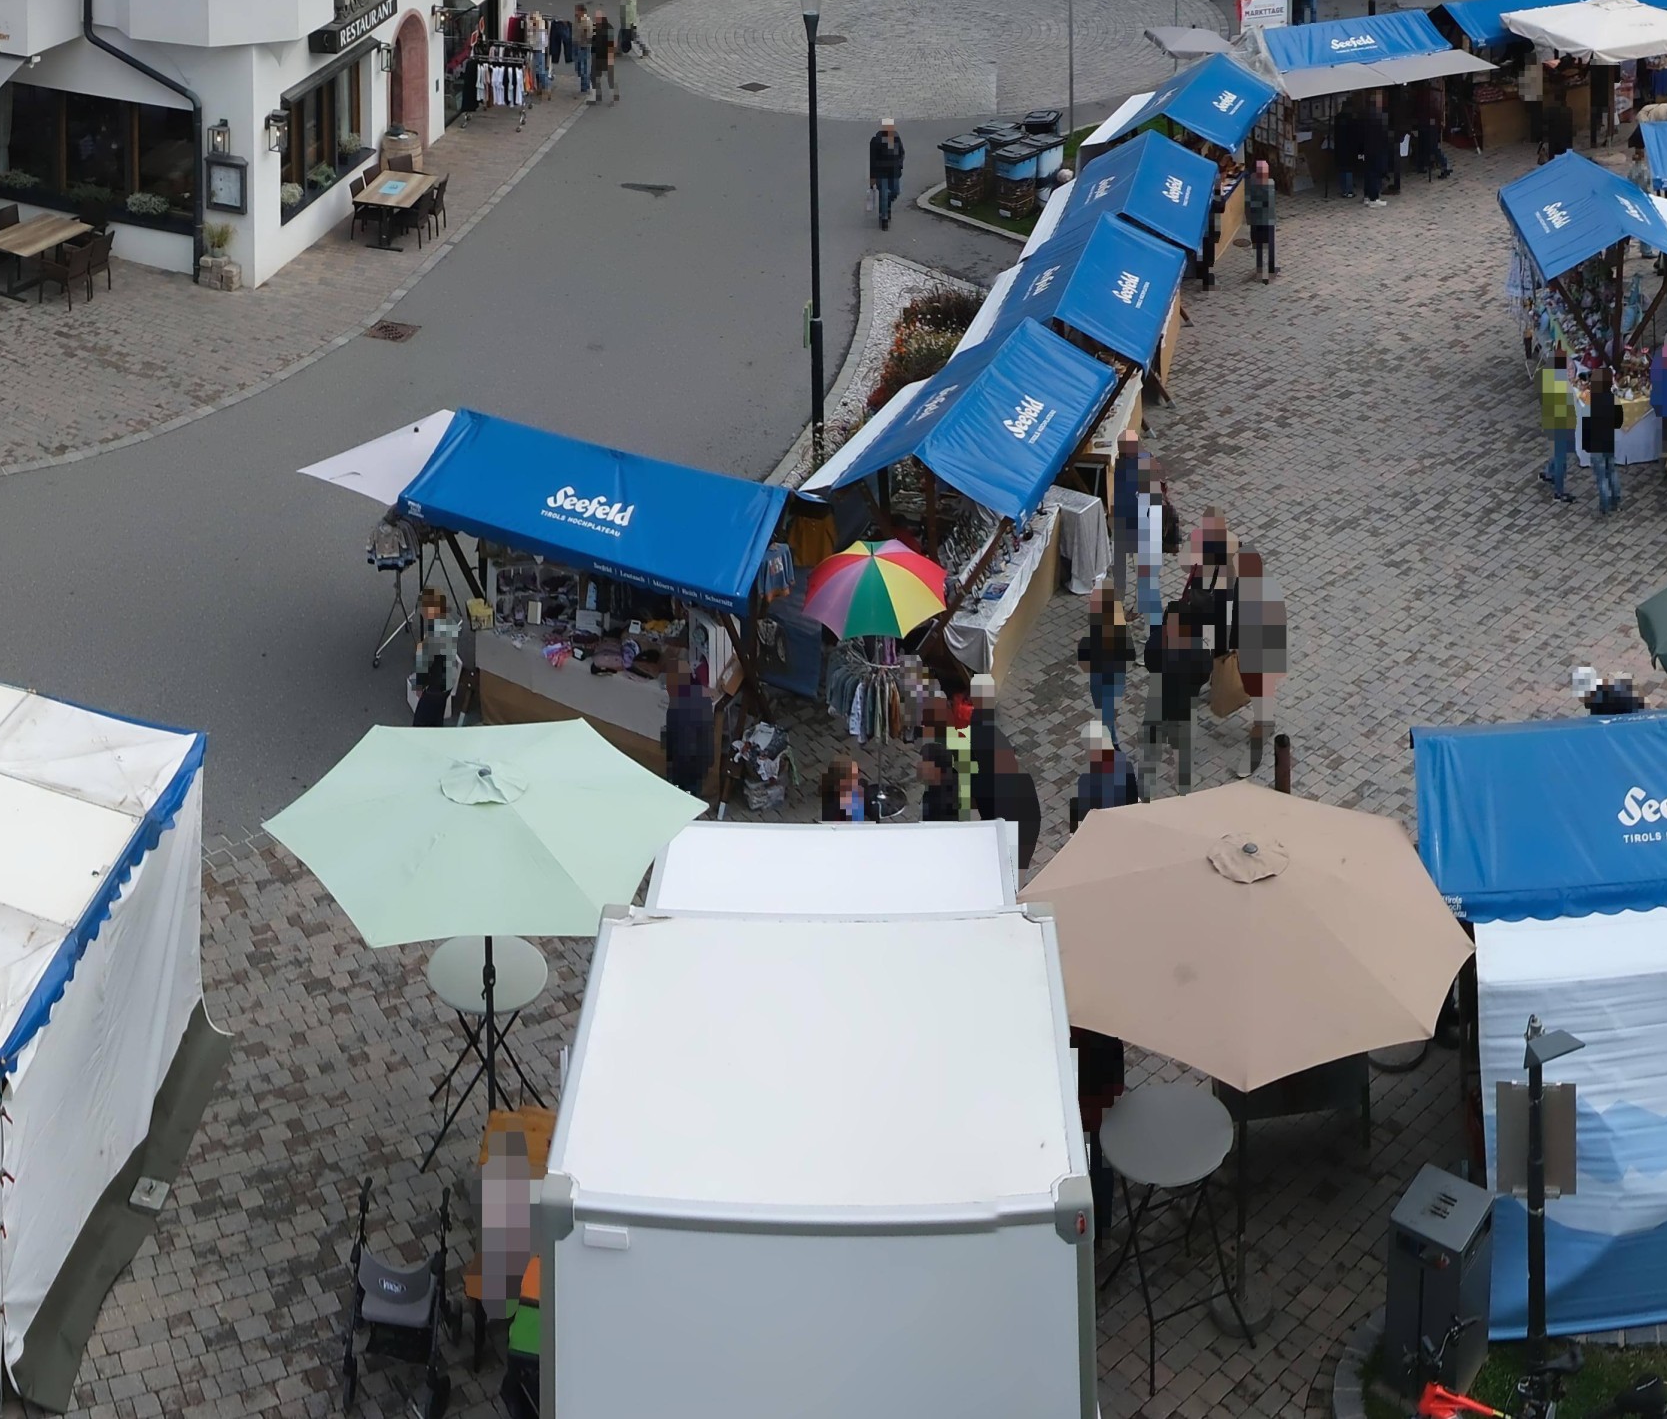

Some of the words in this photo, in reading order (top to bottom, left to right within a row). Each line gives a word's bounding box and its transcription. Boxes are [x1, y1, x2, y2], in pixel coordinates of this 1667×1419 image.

[1244, 6, 1285, 17] MARKTTAGE
[1330, 34, 1375, 50] Seefeld
[1003, 394, 1045, 439] Seefeld
[546, 485, 635, 527] Seefeld
[540, 509, 566, 521] TIROLS
[567, 516, 621, 538] HOCHPLATEAU
[1623, 832, 1662, 845] TIROLS
